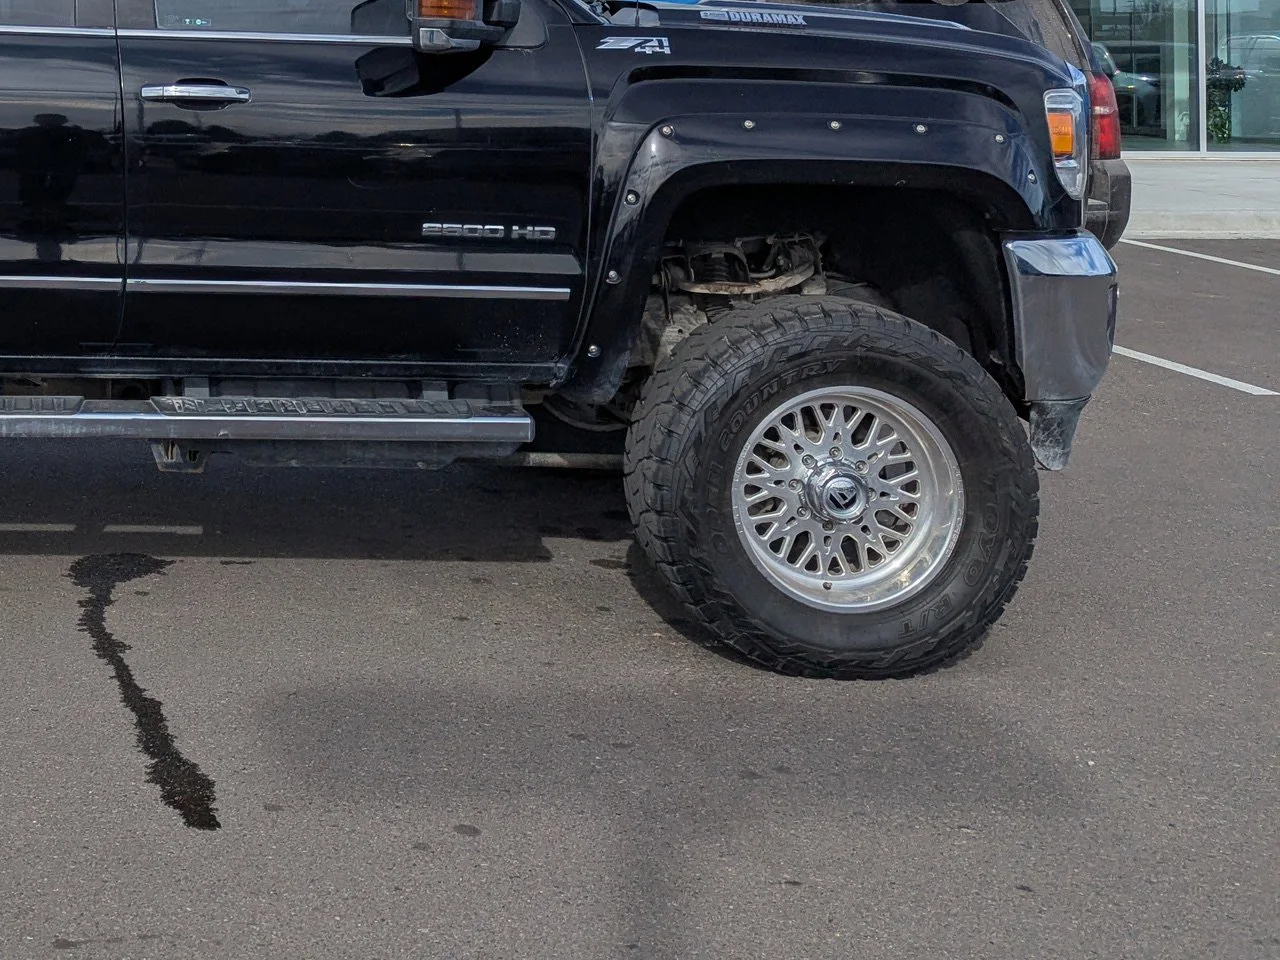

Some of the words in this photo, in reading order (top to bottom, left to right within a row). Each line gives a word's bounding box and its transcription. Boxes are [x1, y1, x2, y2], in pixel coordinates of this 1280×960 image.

[728, 11, 808, 26] DURAMAX
[422, 223, 505, 238] 2500
[511, 225, 556, 240] HD
[719, 357, 847, 453] COUNTRY
[897, 594, 955, 640] R/T
